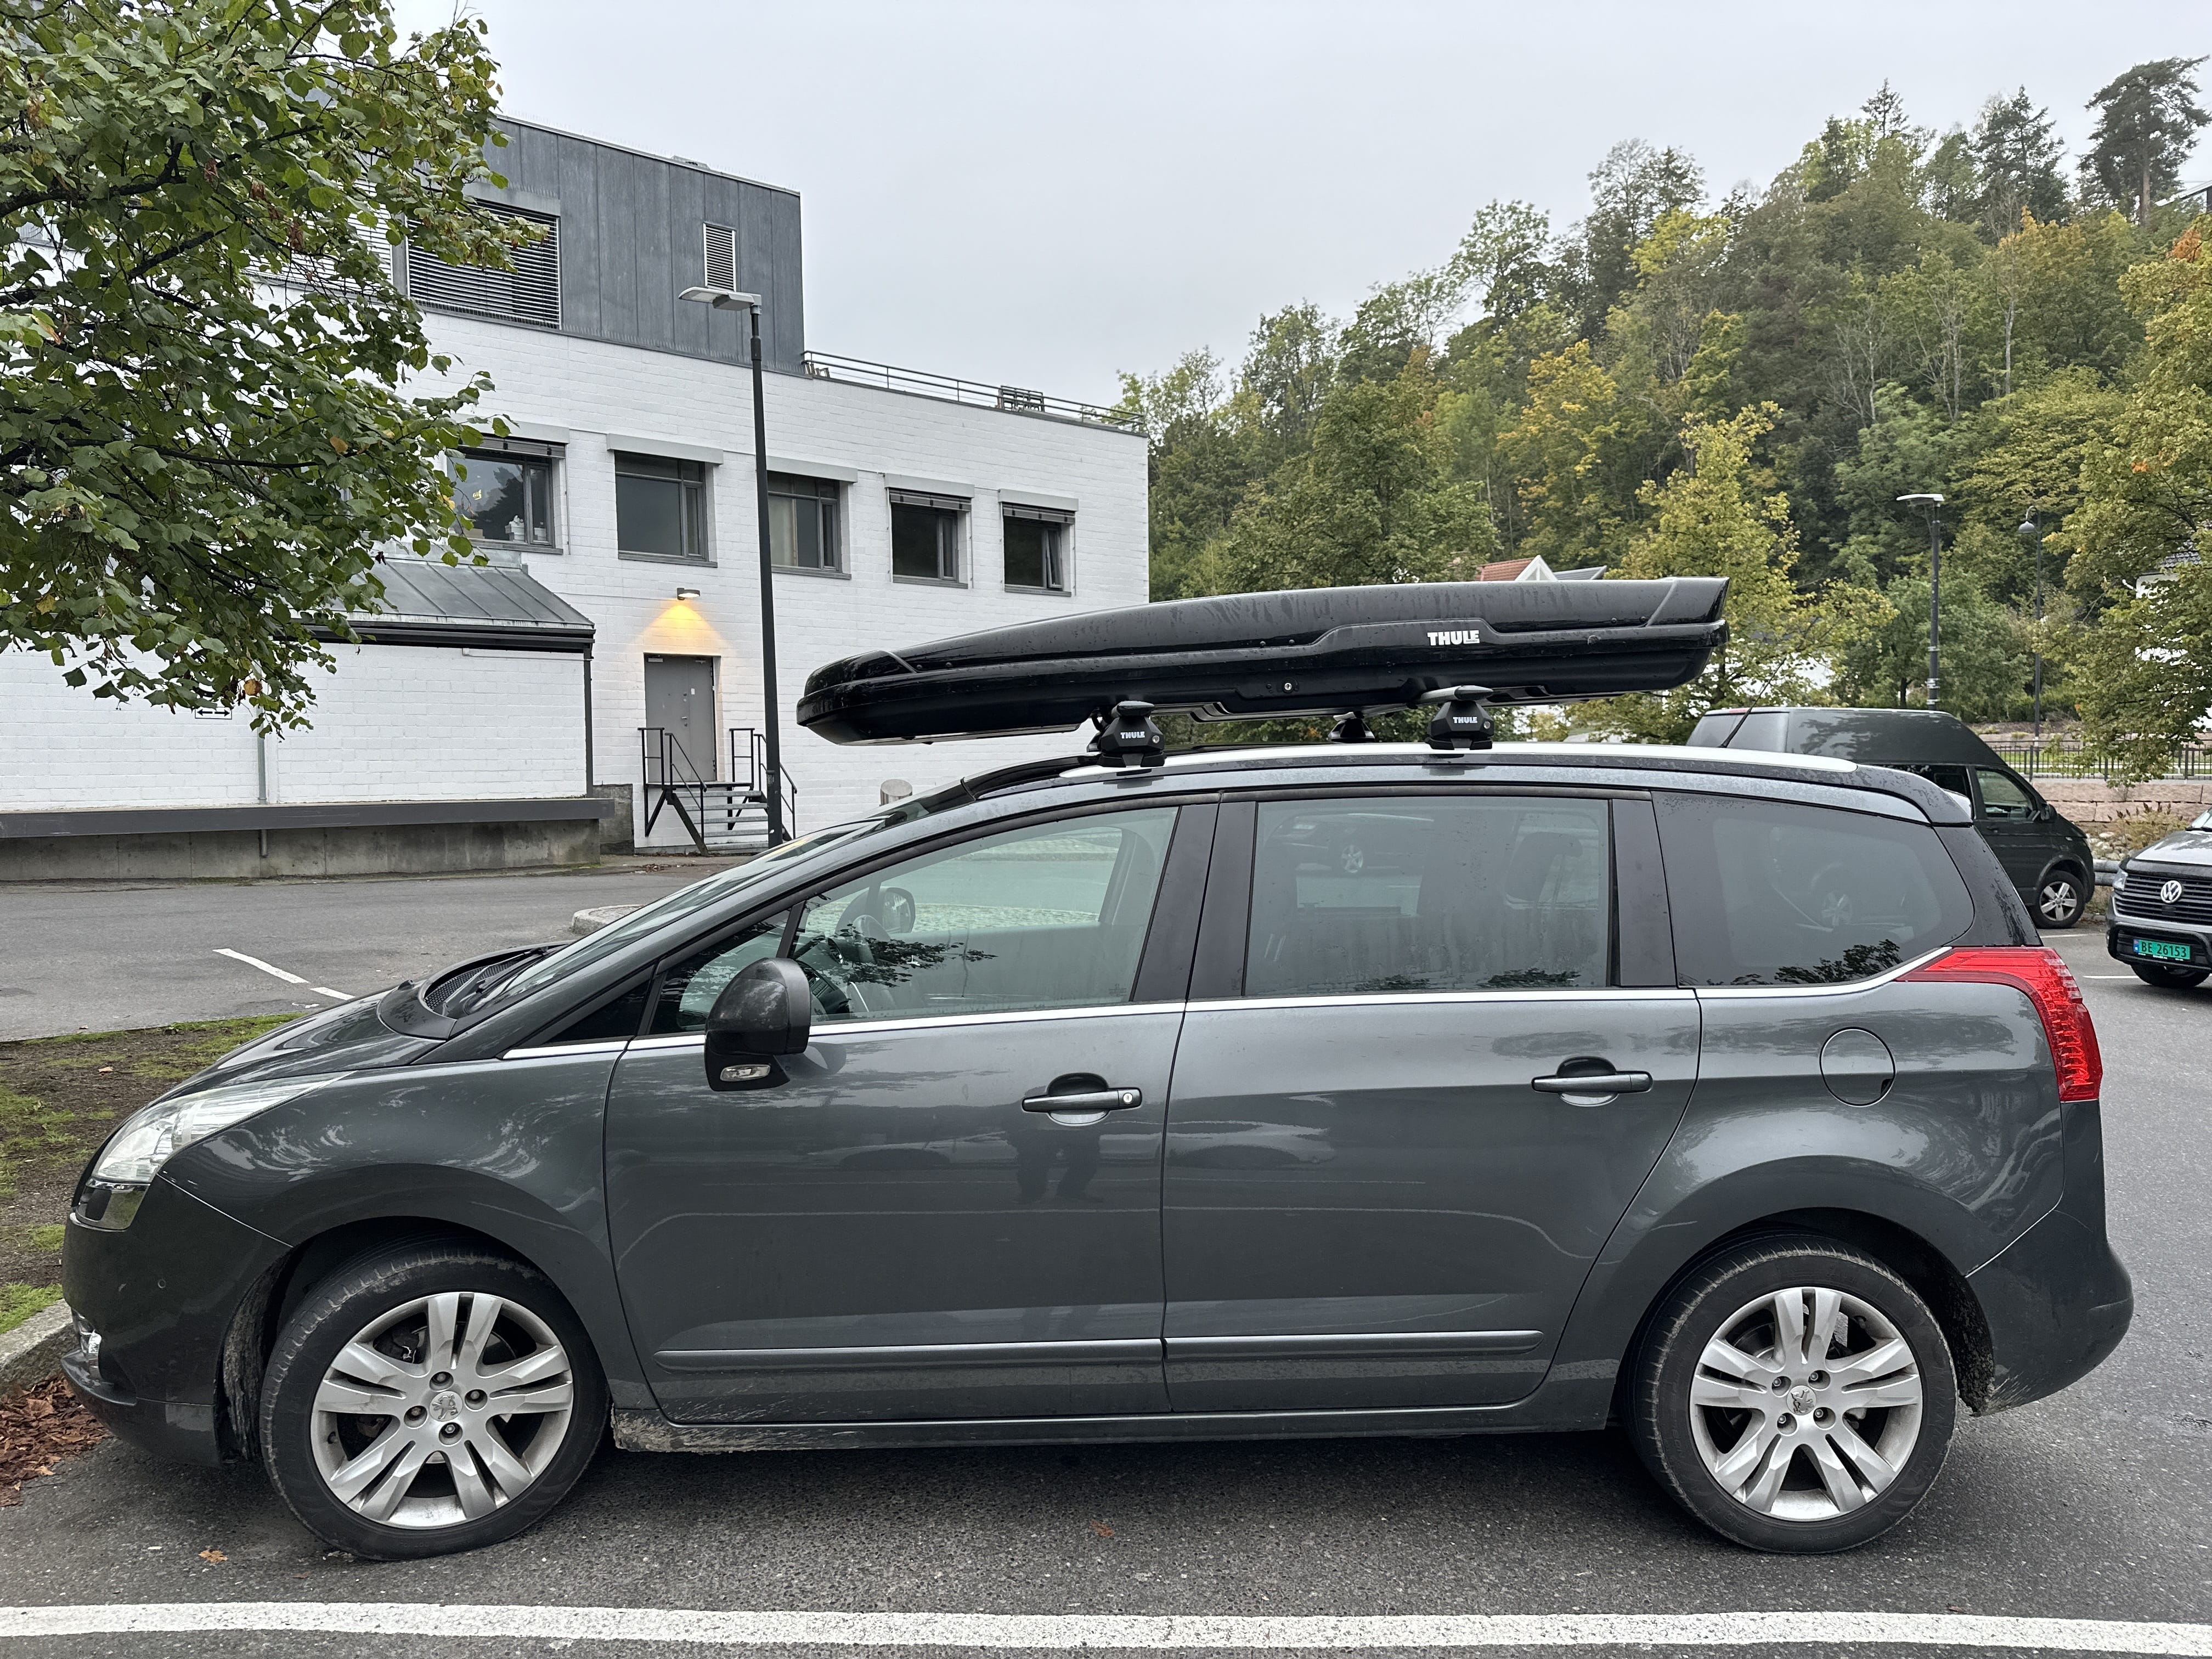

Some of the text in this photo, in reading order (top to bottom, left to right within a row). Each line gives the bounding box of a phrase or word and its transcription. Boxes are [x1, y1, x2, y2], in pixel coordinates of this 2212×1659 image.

[1427, 630, 1480, 646] THULE
[1120, 731, 1146, 739] THULE
[2141, 941, 2153, 953] BE
[2157, 944, 2187, 957] 26153
